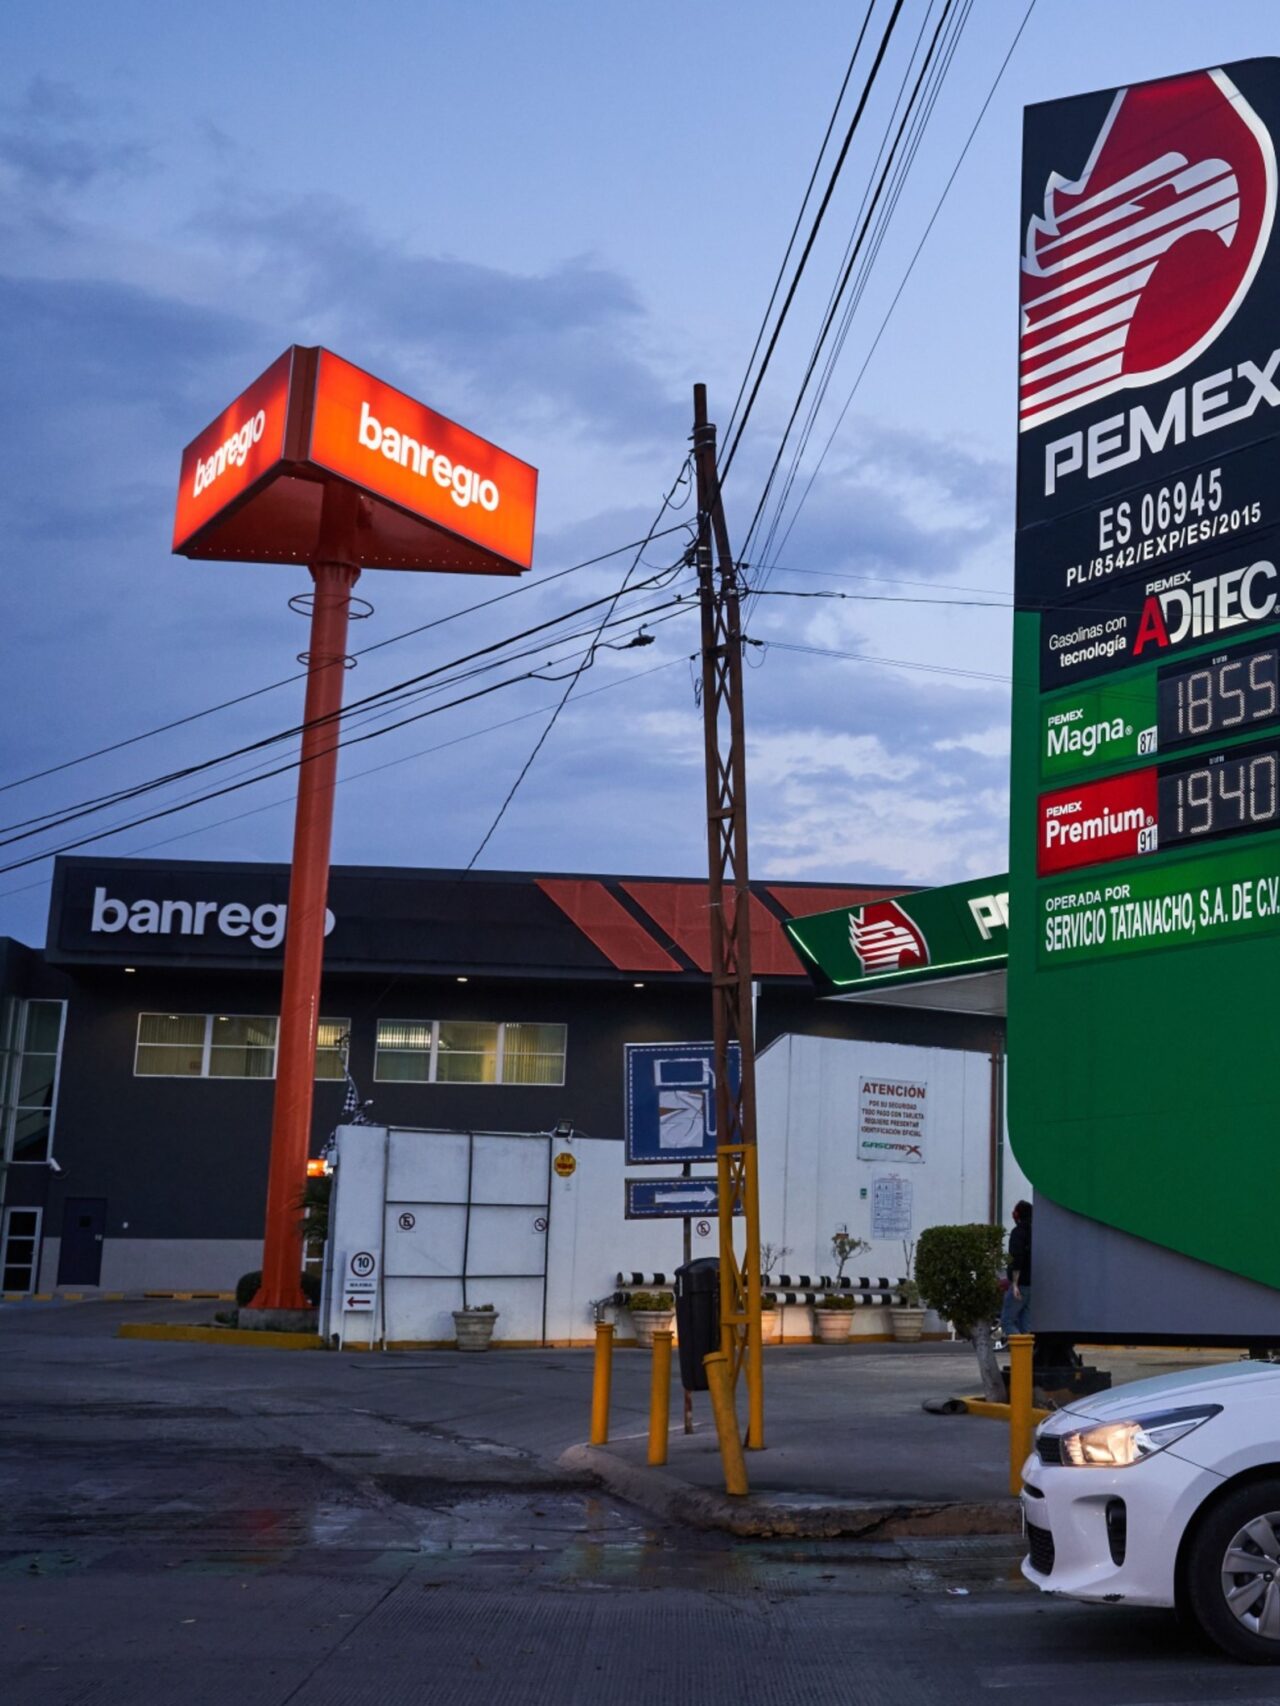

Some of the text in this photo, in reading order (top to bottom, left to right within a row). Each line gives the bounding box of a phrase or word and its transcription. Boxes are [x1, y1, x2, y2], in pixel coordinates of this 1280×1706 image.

[193, 409, 265, 498] banregio
[358, 401, 499, 511] banregio
[1099, 468, 1222, 551] ES 06945
[1066, 502, 1262, 587] PL/8542/EXP/ES/2015
[1146, 570, 1191, 595] PEMEX
[1049, 616, 1127, 651] Gasolinas con
[1060, 634, 1127, 667] tecnología
[1048, 708, 1084, 727] PEMEX
[1047, 718, 1124, 757] Magna
[1140, 732, 1153, 753] 87
[1046, 801, 1082, 818] PEMEX
[1046, 807, 1145, 848] Premium
[1140, 831, 1153, 852] 91
[1045, 884, 1130, 911] OPERADA POR
[1045, 907, 1106, 952] SERVICIO
[1110, 892, 1196, 941] TATANACHO,
[1200, 886, 1228, 926] S.A.
[1232, 881, 1252, 921] DE
[1256, 876, 1280, 917] C.V.
[91, 887, 336, 949] banreg
[862, 1082, 925, 1099] ATENCIÓN
[357, 1257, 369, 1268] 10
